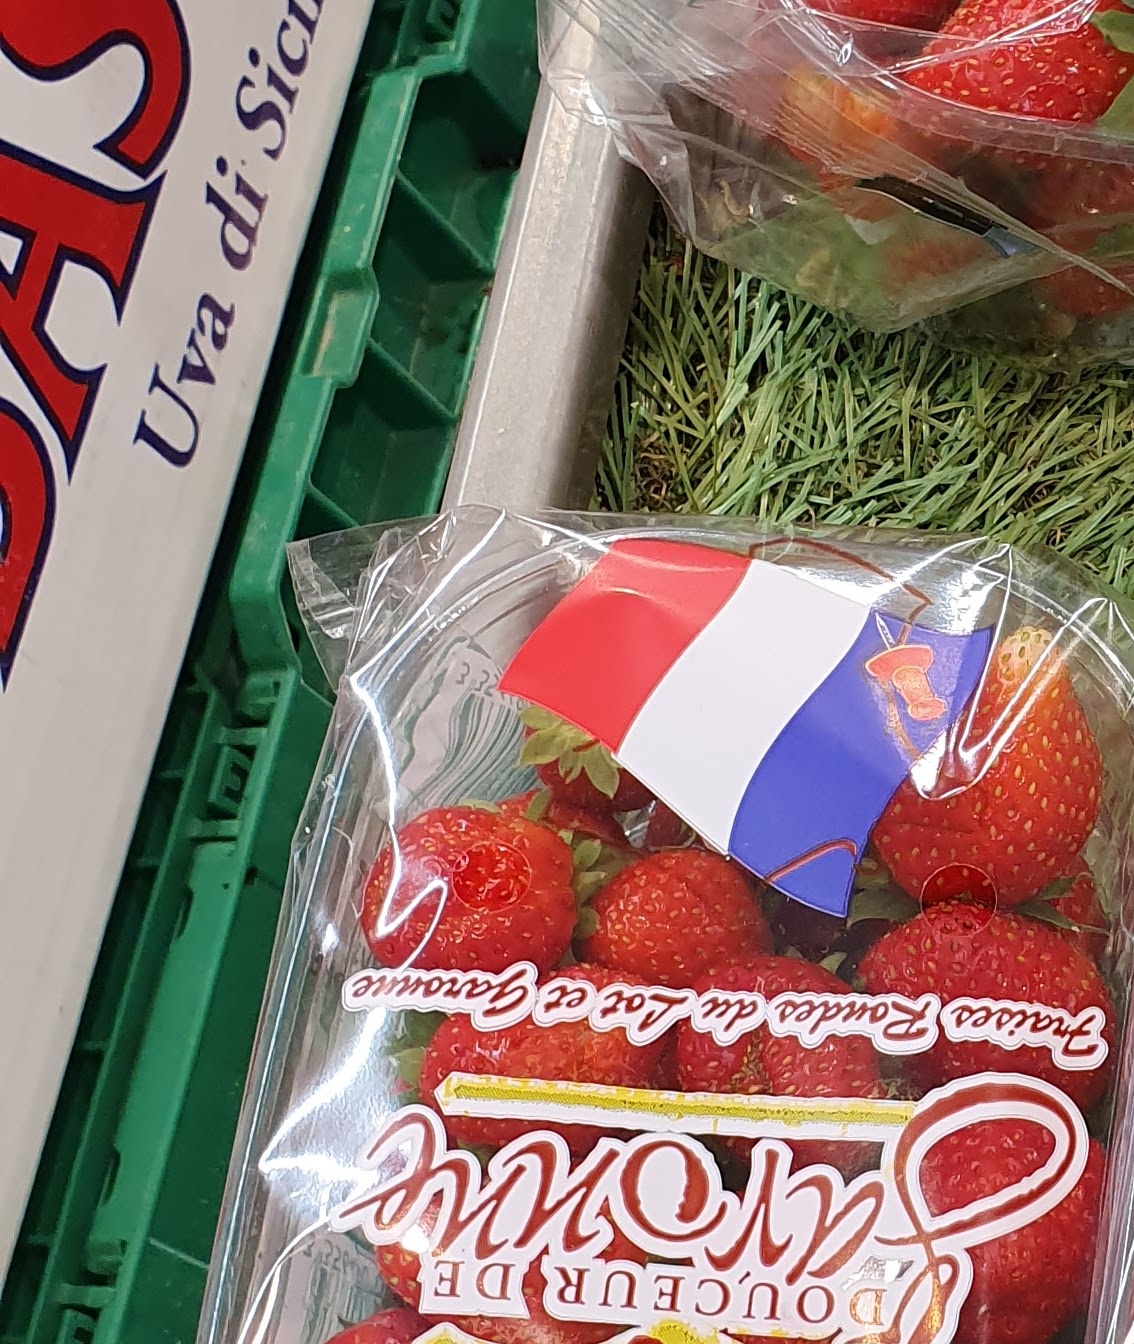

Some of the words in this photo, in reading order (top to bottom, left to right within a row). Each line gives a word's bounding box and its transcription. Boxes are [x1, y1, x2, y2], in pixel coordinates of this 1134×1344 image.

[132, 290, 236, 468] Uva
[204, 154, 269, 272] di
[351, 967, 530, 1018] Garonne
[543, 984, 589, 1014] et
[599, 991, 689, 1033] Lot
[700, 996, 758, 1033] du
[774, 998, 936, 1042] Rondes
[950, 1003, 1103, 1058] Fraises
[432, 1258, 515, 1302] DE
[556, 1265, 888, 1328] DOUCEUR
